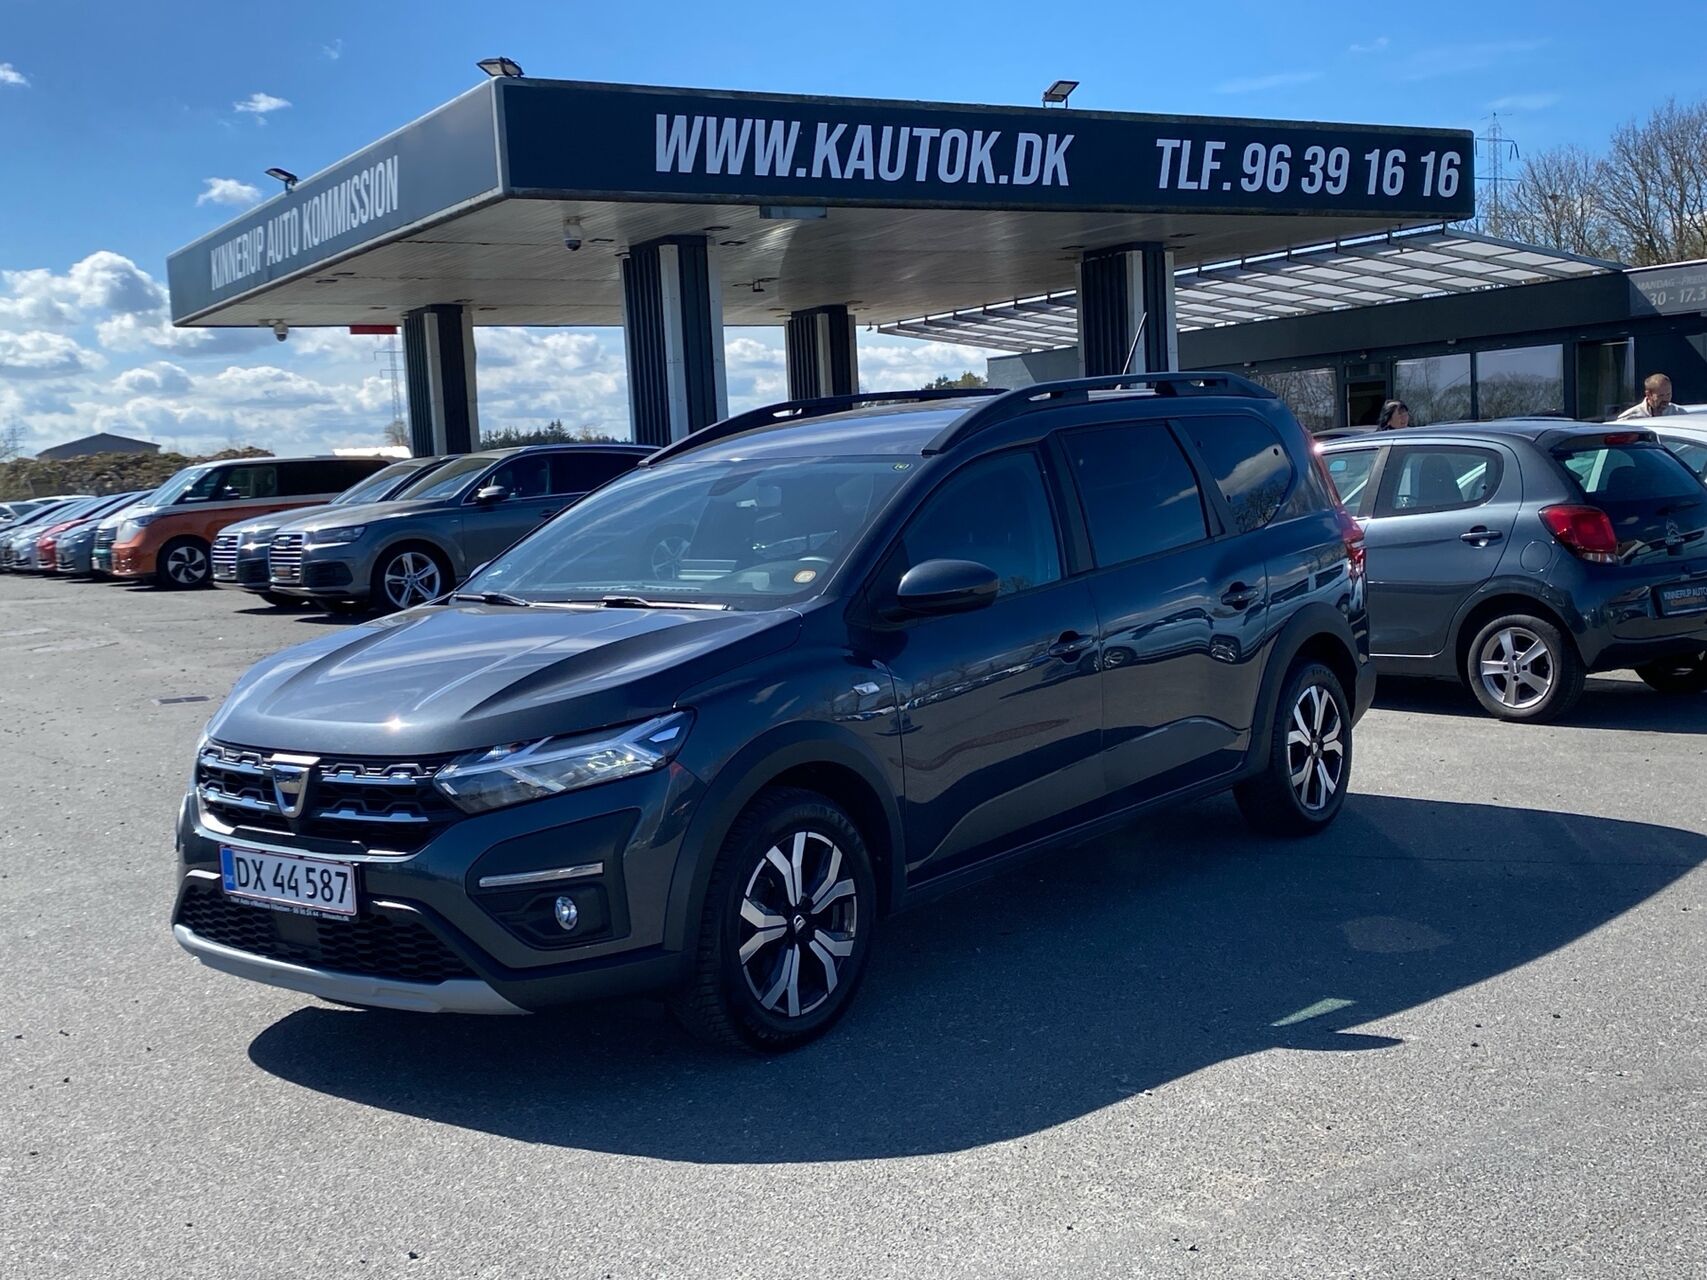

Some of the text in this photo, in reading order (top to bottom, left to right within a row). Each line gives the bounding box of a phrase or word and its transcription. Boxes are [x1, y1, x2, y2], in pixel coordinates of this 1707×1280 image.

[655, 113, 1075, 187] WWW.KAUTOK.DK
[1156, 138, 1461, 198] TLF. 96 39 16 16
[210, 154, 399, 291] KINNERUP AUTO KOMMISSION
[235, 856, 349, 904] DX 44 587
